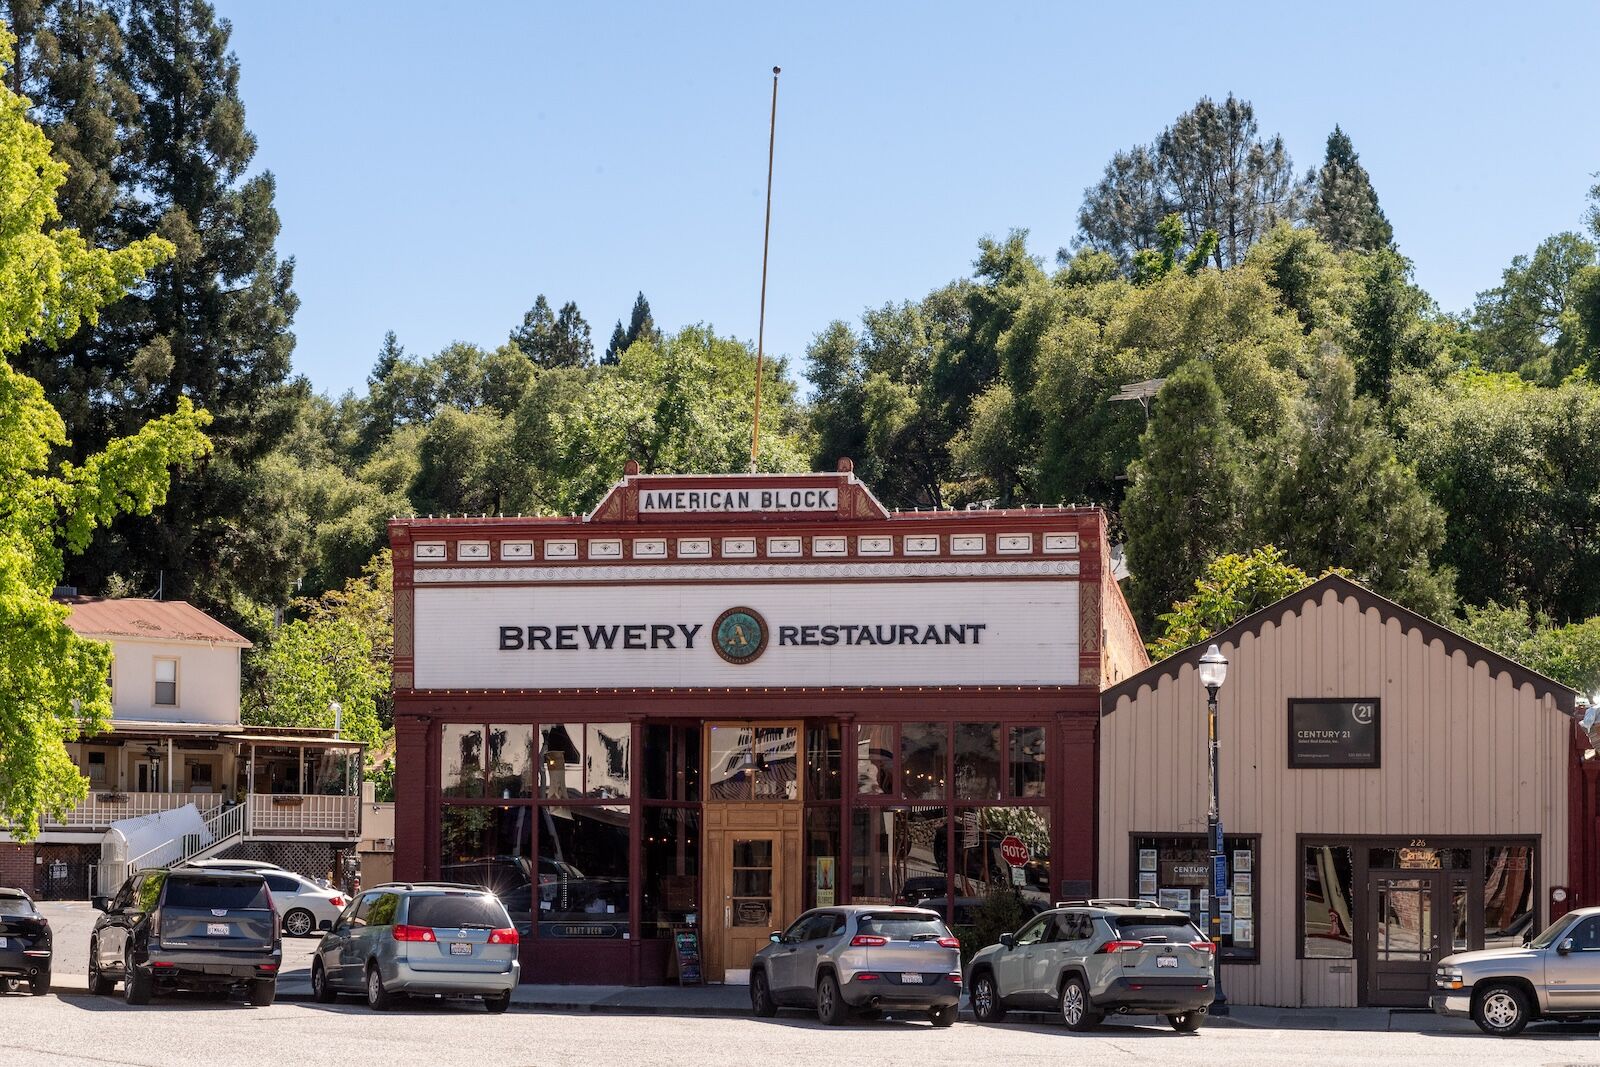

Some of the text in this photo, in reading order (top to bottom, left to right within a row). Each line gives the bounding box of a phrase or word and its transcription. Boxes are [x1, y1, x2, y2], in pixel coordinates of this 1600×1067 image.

[645, 490, 837, 509] AMERICAN BLOCK.
[499, 624, 703, 651] BREWERY
[779, 623, 987, 646] RESTAURANT
[1297, 730, 1351, 738] CENTURY 21
[1410, 839, 1427, 847] 226
